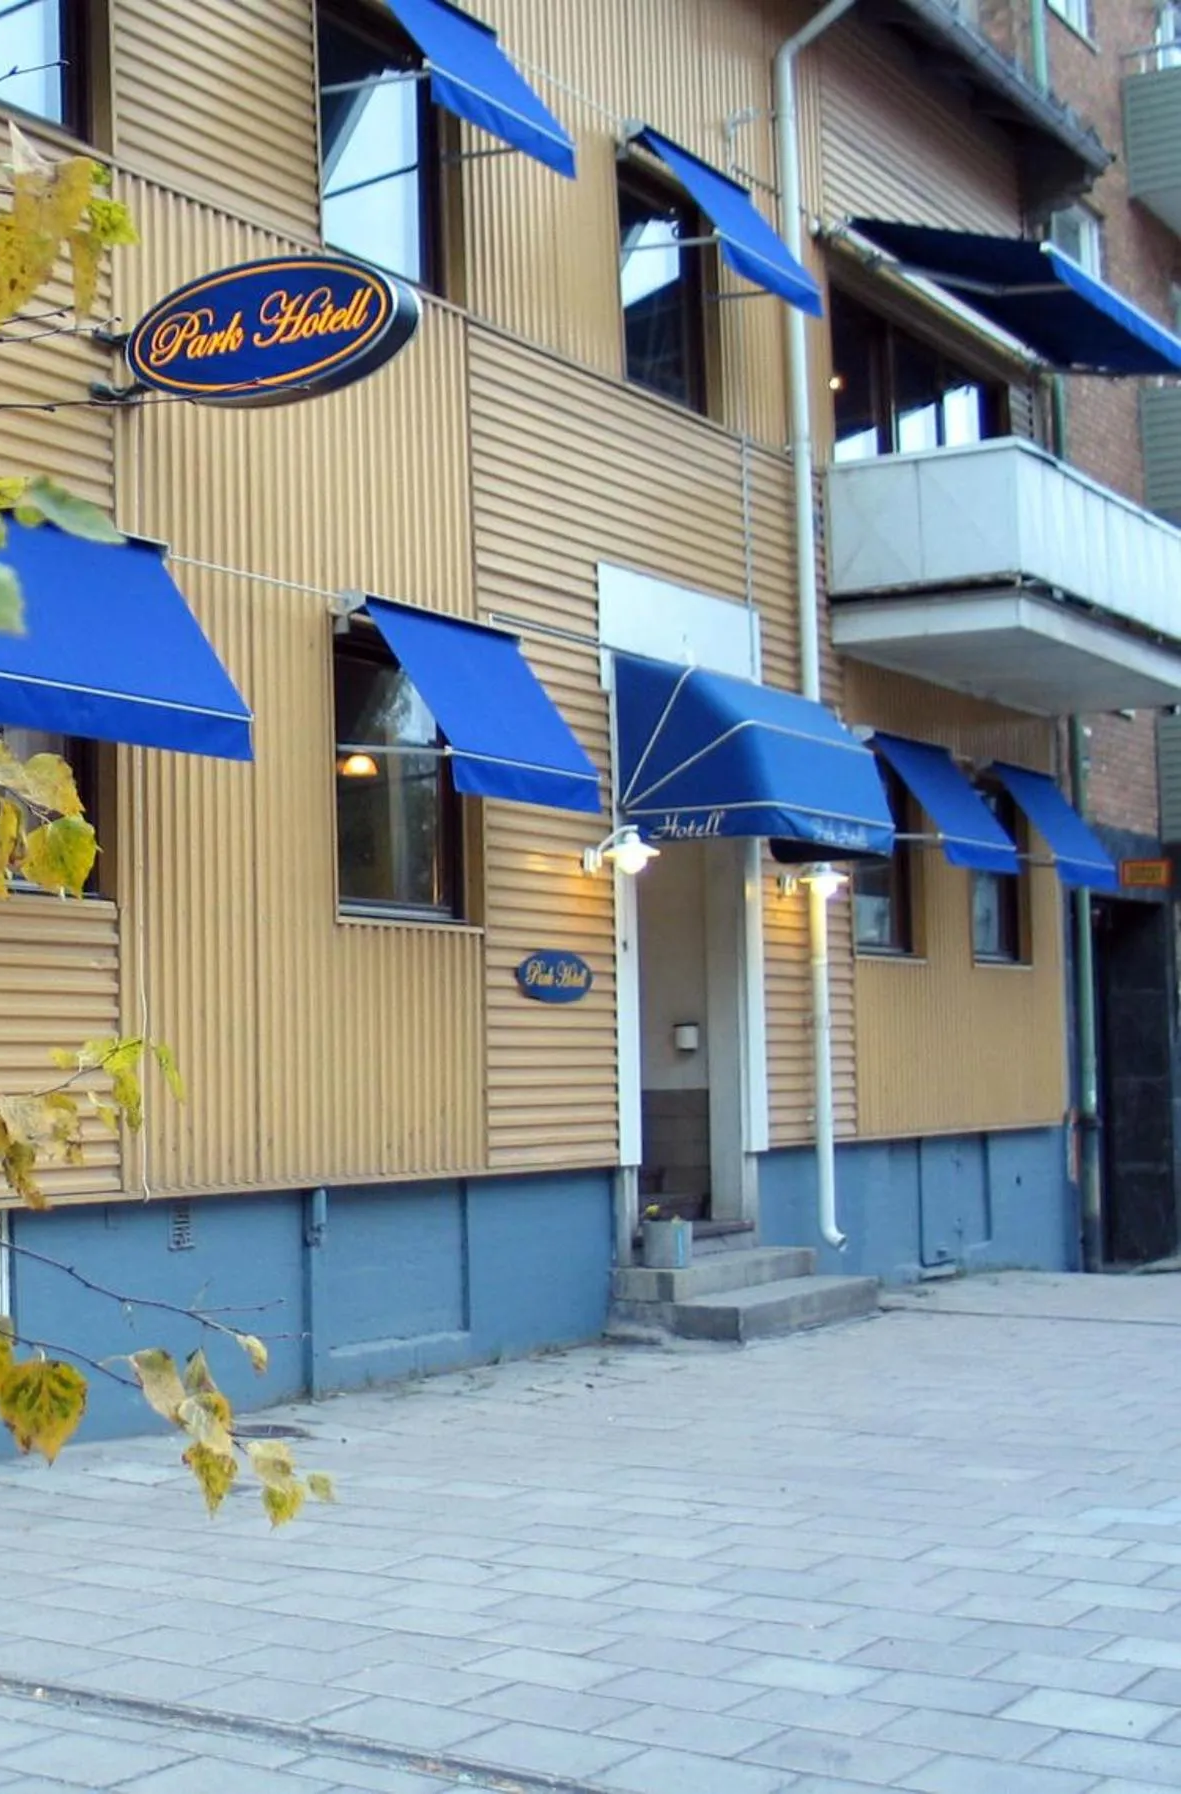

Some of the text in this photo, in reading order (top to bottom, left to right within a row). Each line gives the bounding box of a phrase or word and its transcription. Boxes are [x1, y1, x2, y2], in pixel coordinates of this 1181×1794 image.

[149, 286, 373, 366] Park Hotell
[648, 810, 724, 839] Hotell
